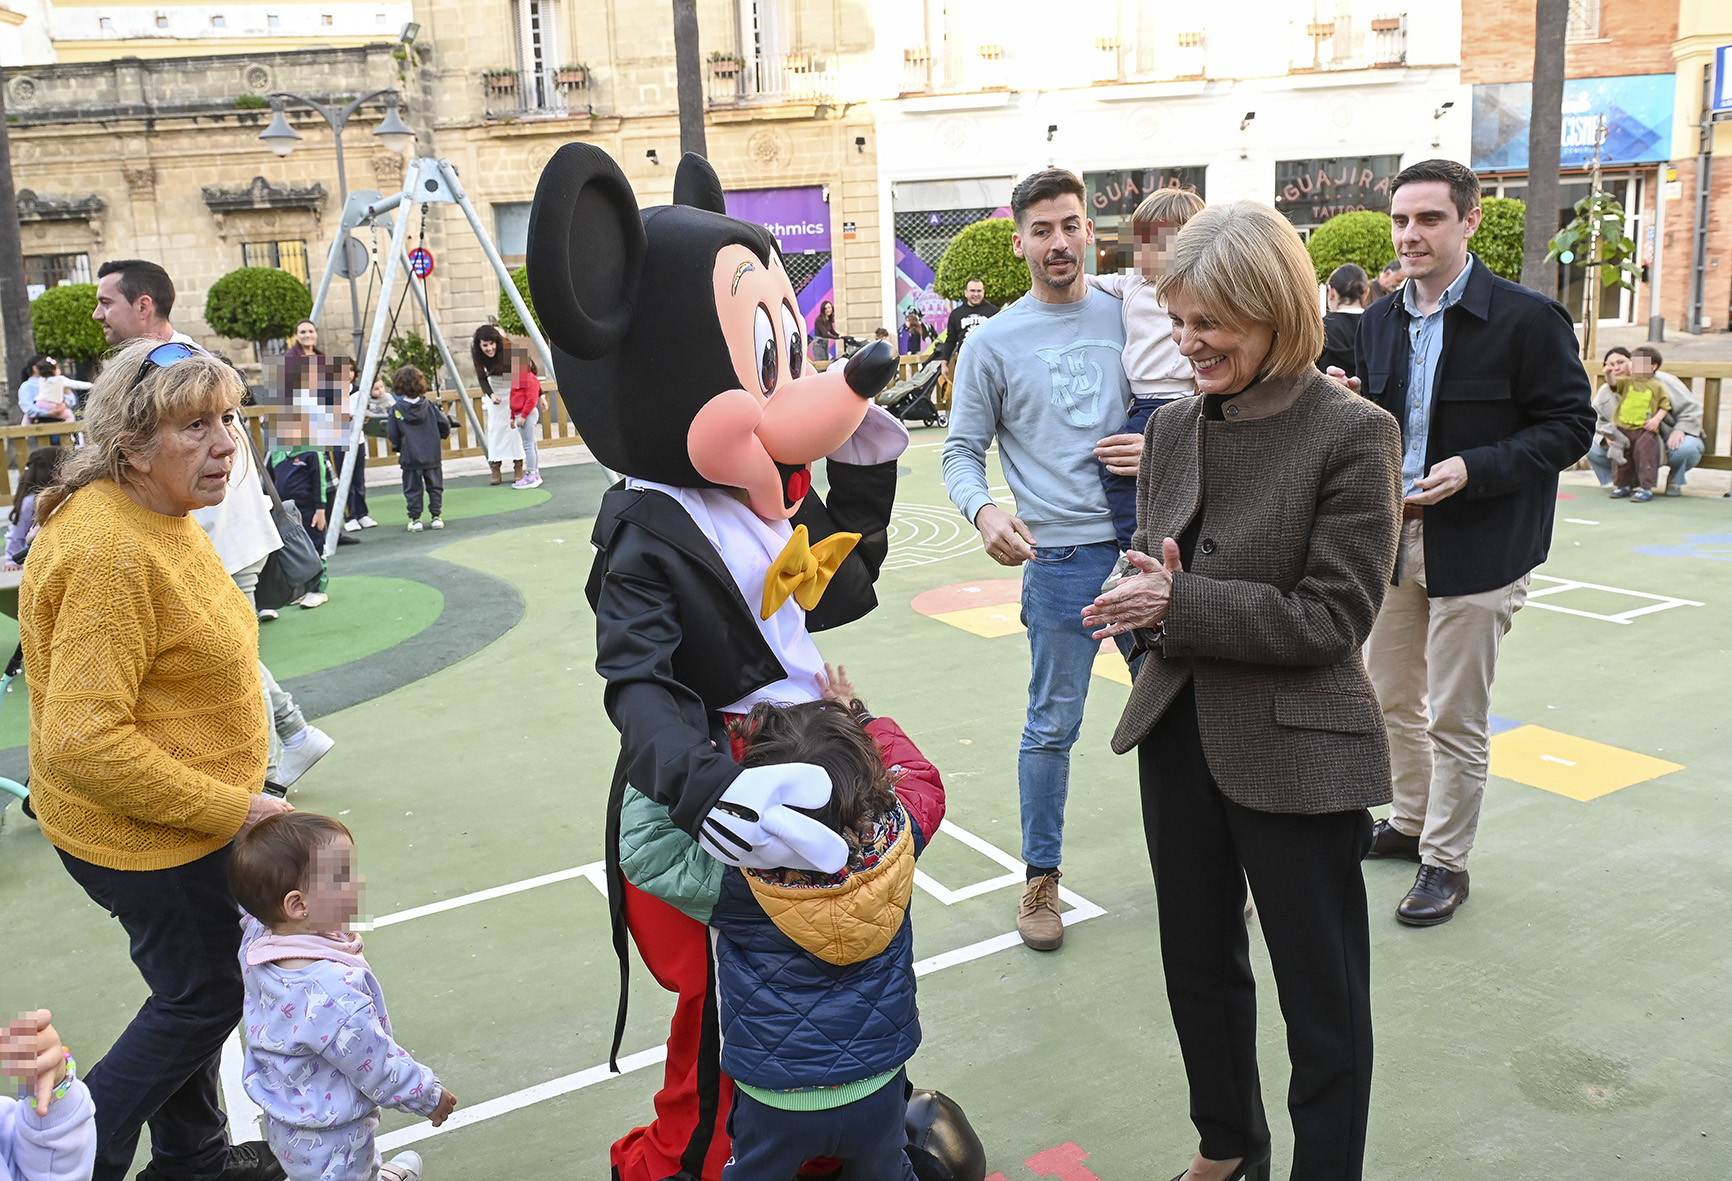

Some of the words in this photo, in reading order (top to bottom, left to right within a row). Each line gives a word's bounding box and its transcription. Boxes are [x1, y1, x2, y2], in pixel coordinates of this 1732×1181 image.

[1564, 147, 1605, 155] COMERCL
[1283, 167, 1390, 201] GUAJIRA
[763, 220, 824, 236] ithmics
